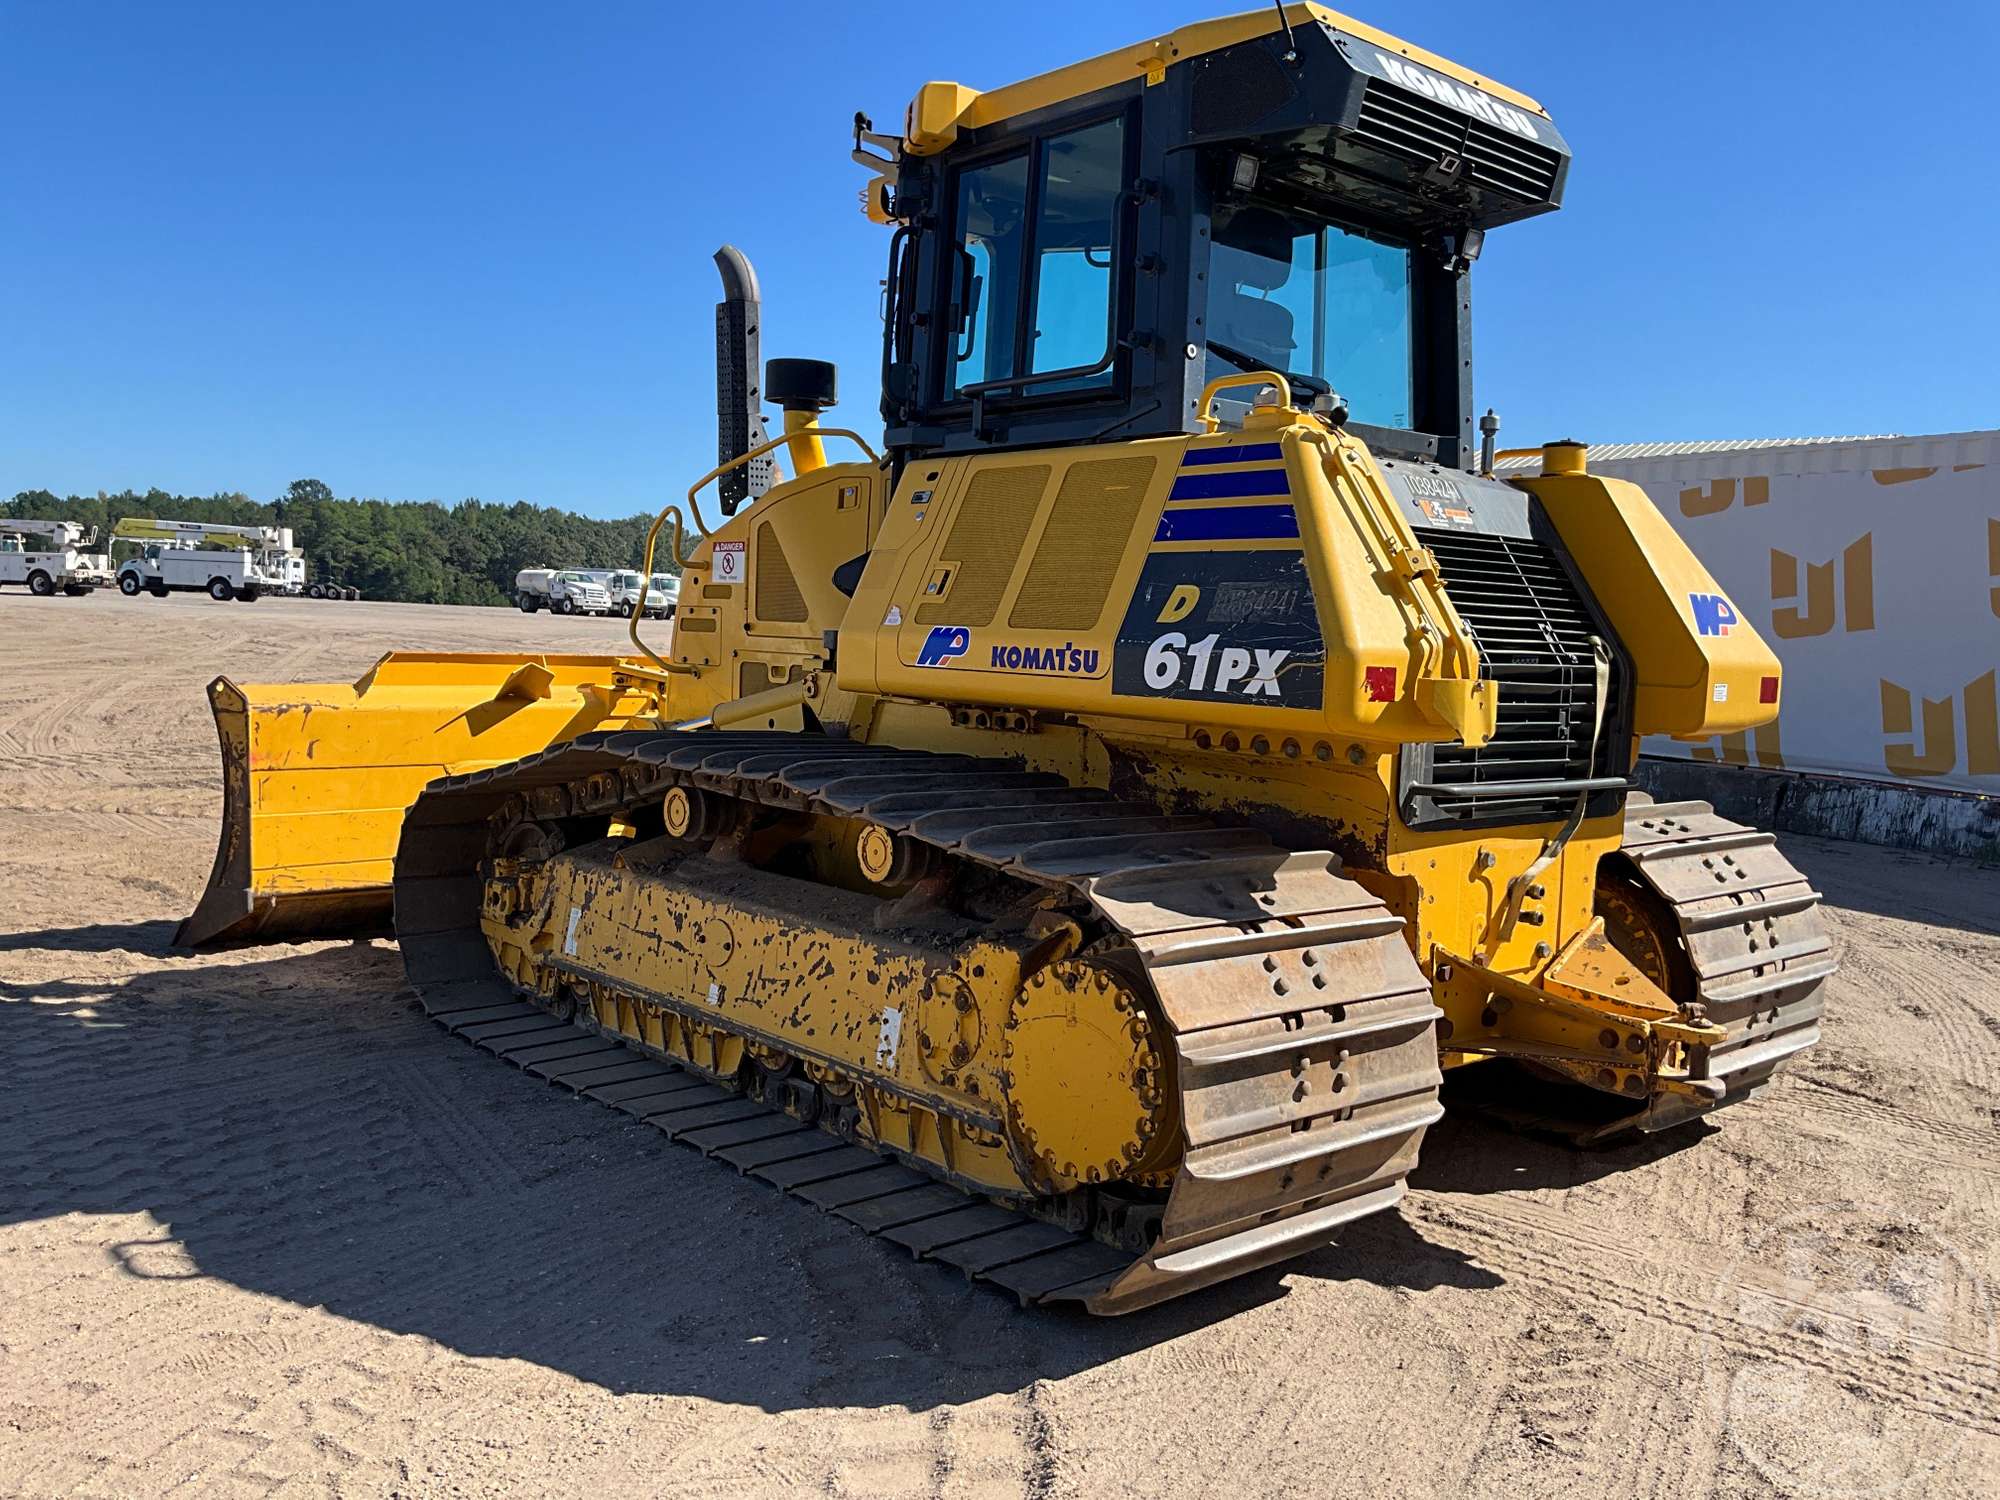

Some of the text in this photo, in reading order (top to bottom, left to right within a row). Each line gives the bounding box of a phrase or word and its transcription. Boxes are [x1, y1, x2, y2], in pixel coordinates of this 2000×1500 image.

[1375, 53, 1539, 139] KOMATSU
[1156, 584, 1201, 623] D
[991, 642, 1098, 673] KOMATSU
[1143, 631, 1291, 696] 61PX
